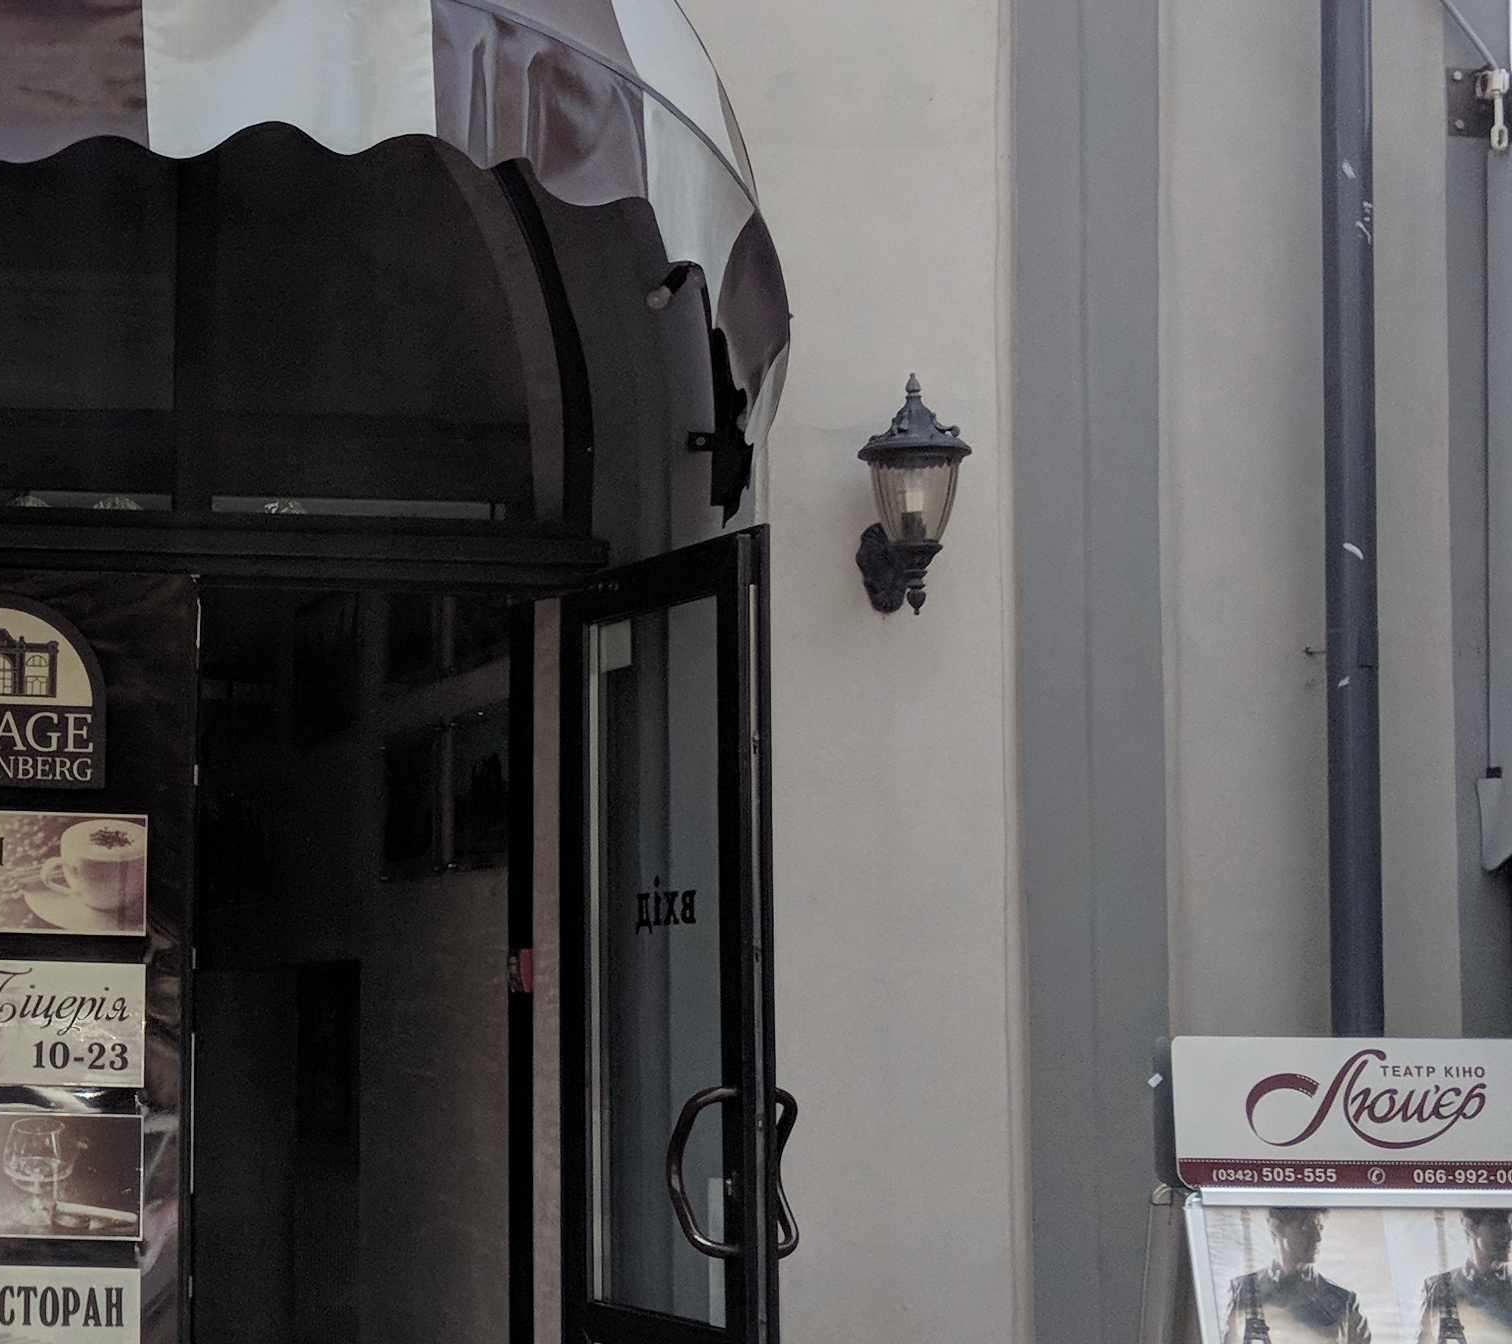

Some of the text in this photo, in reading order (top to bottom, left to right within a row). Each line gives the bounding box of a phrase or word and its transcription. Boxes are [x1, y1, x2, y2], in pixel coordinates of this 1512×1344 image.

[33, 1041, 129, 1070] 10-23
[1380, 1065, 1486, 1078] ТЕАТР КІНО
[1212, 1169, 1258, 1183] (0342)
[1262, 1167, 1337, 1184] 505-555
